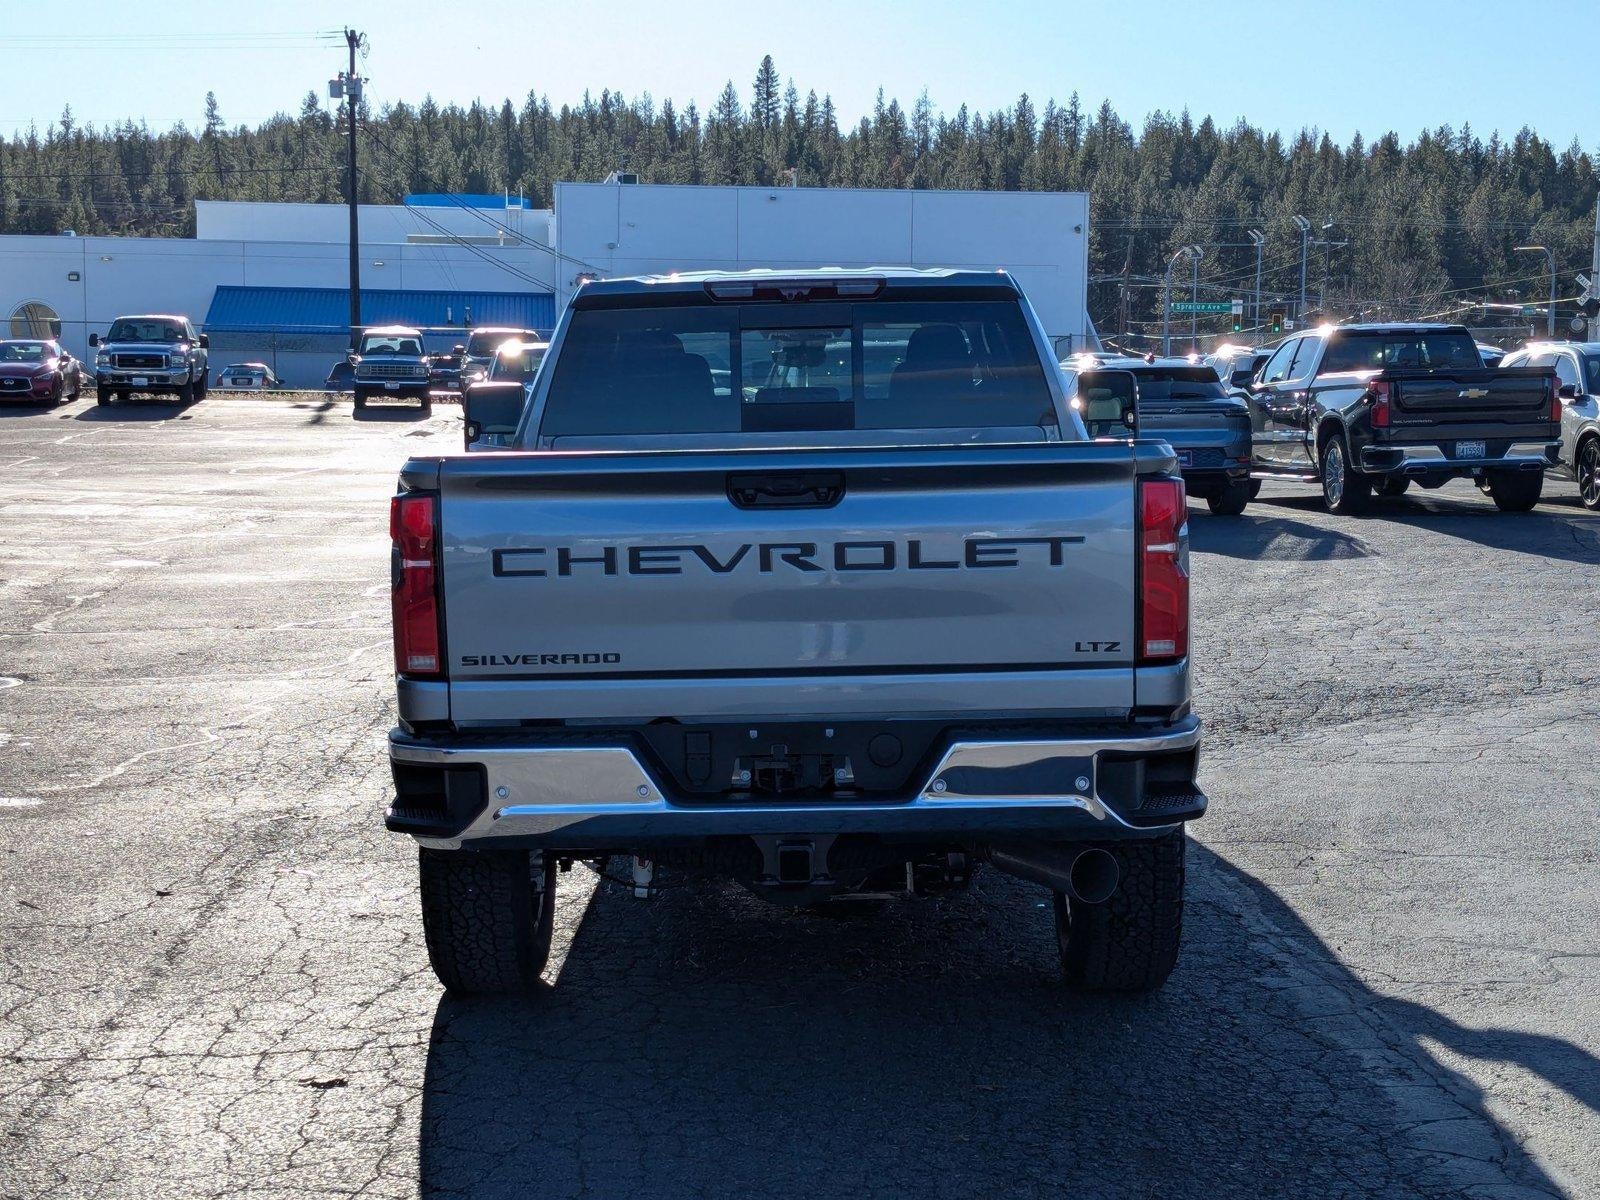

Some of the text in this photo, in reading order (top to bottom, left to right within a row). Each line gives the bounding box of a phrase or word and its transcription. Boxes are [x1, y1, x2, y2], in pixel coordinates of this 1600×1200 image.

[492, 536, 1085, 577] CHEVROLET
[1075, 641, 1121, 653] LTZ
[461, 652, 621, 667] SILVERADO
